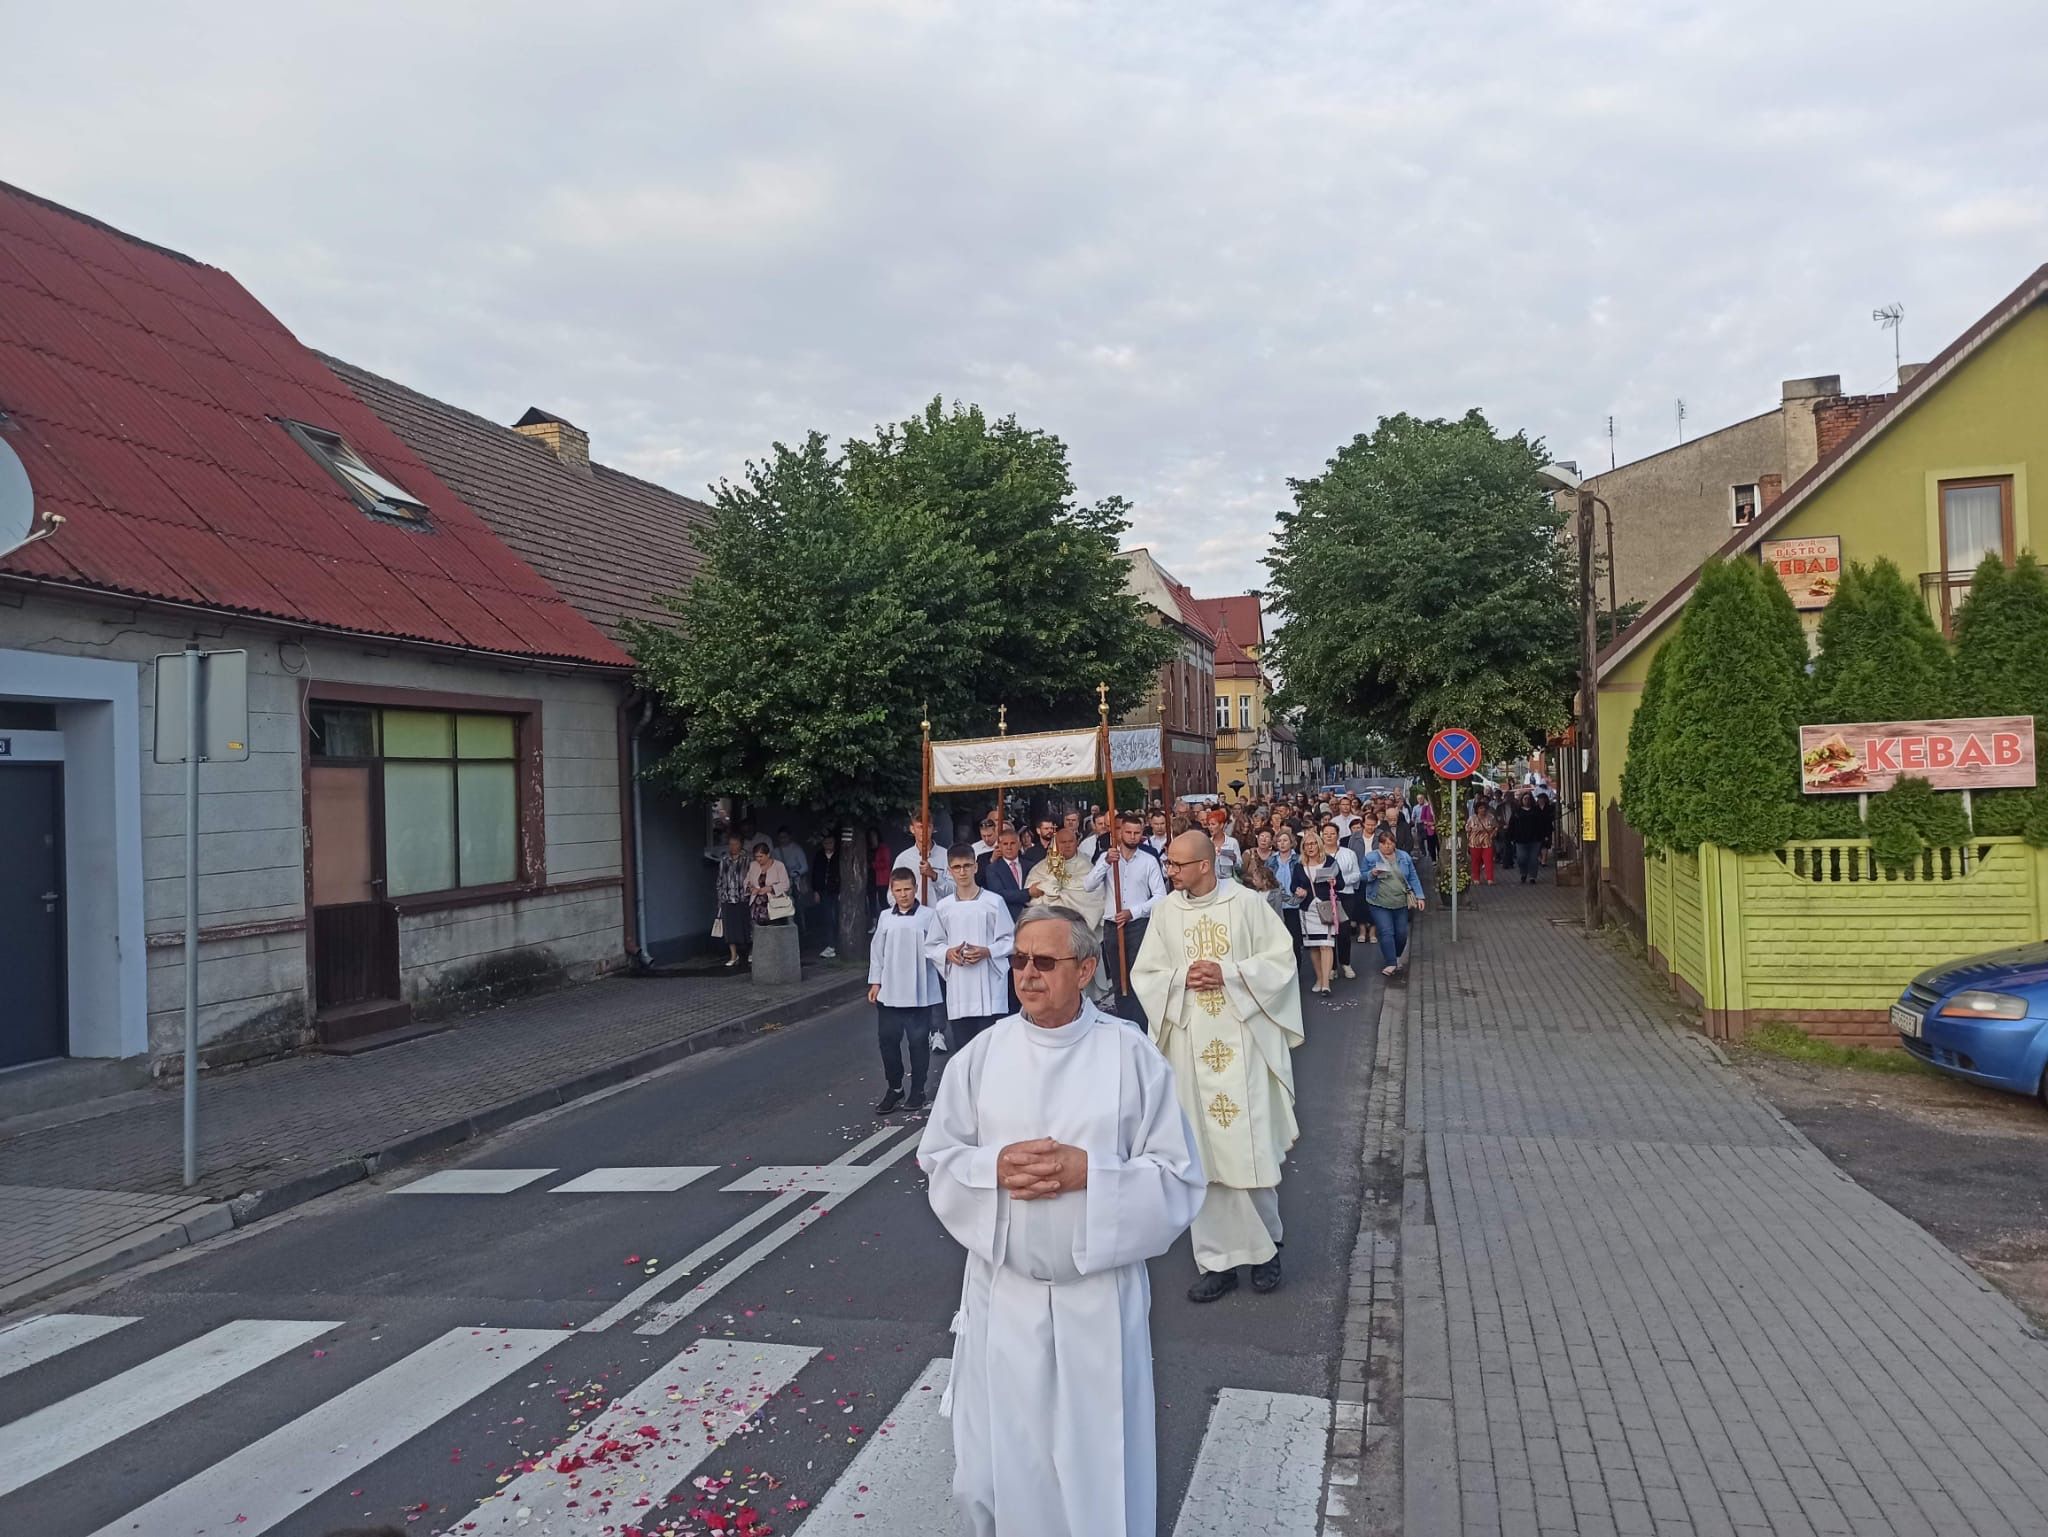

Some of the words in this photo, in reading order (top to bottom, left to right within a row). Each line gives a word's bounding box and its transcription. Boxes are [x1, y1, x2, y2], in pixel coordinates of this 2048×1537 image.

[1776, 546, 1826, 557] BISTRO
[1773, 557, 1839, 576] EBAB
[1865, 733, 2022, 771] KEBAB
